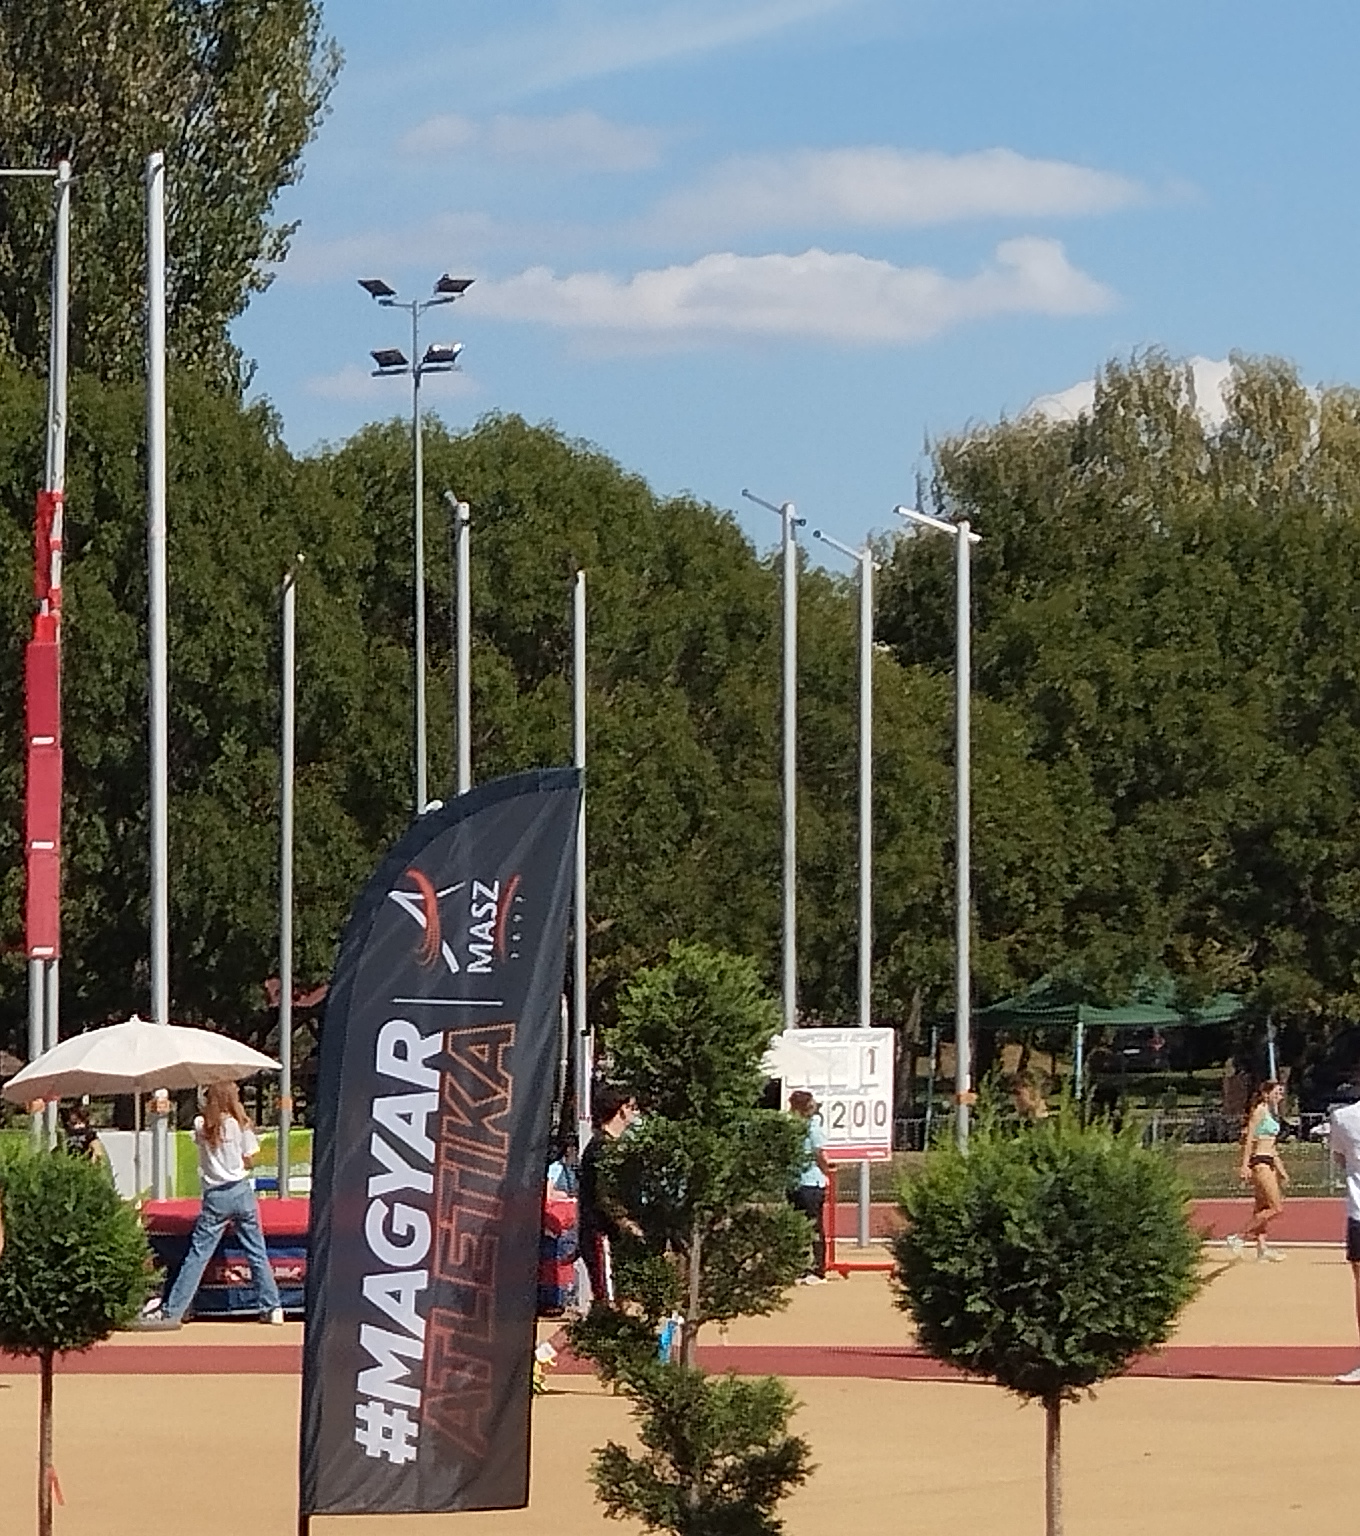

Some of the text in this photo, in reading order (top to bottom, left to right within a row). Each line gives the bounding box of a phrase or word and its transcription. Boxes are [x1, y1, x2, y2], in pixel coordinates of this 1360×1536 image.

[467, 879, 500, 973] MASZ
[866, 1047, 876, 1075] 1
[355, 1019, 444, 1464] #MAGYAR
[423, 1023, 516, 1458] ATLETIKA
